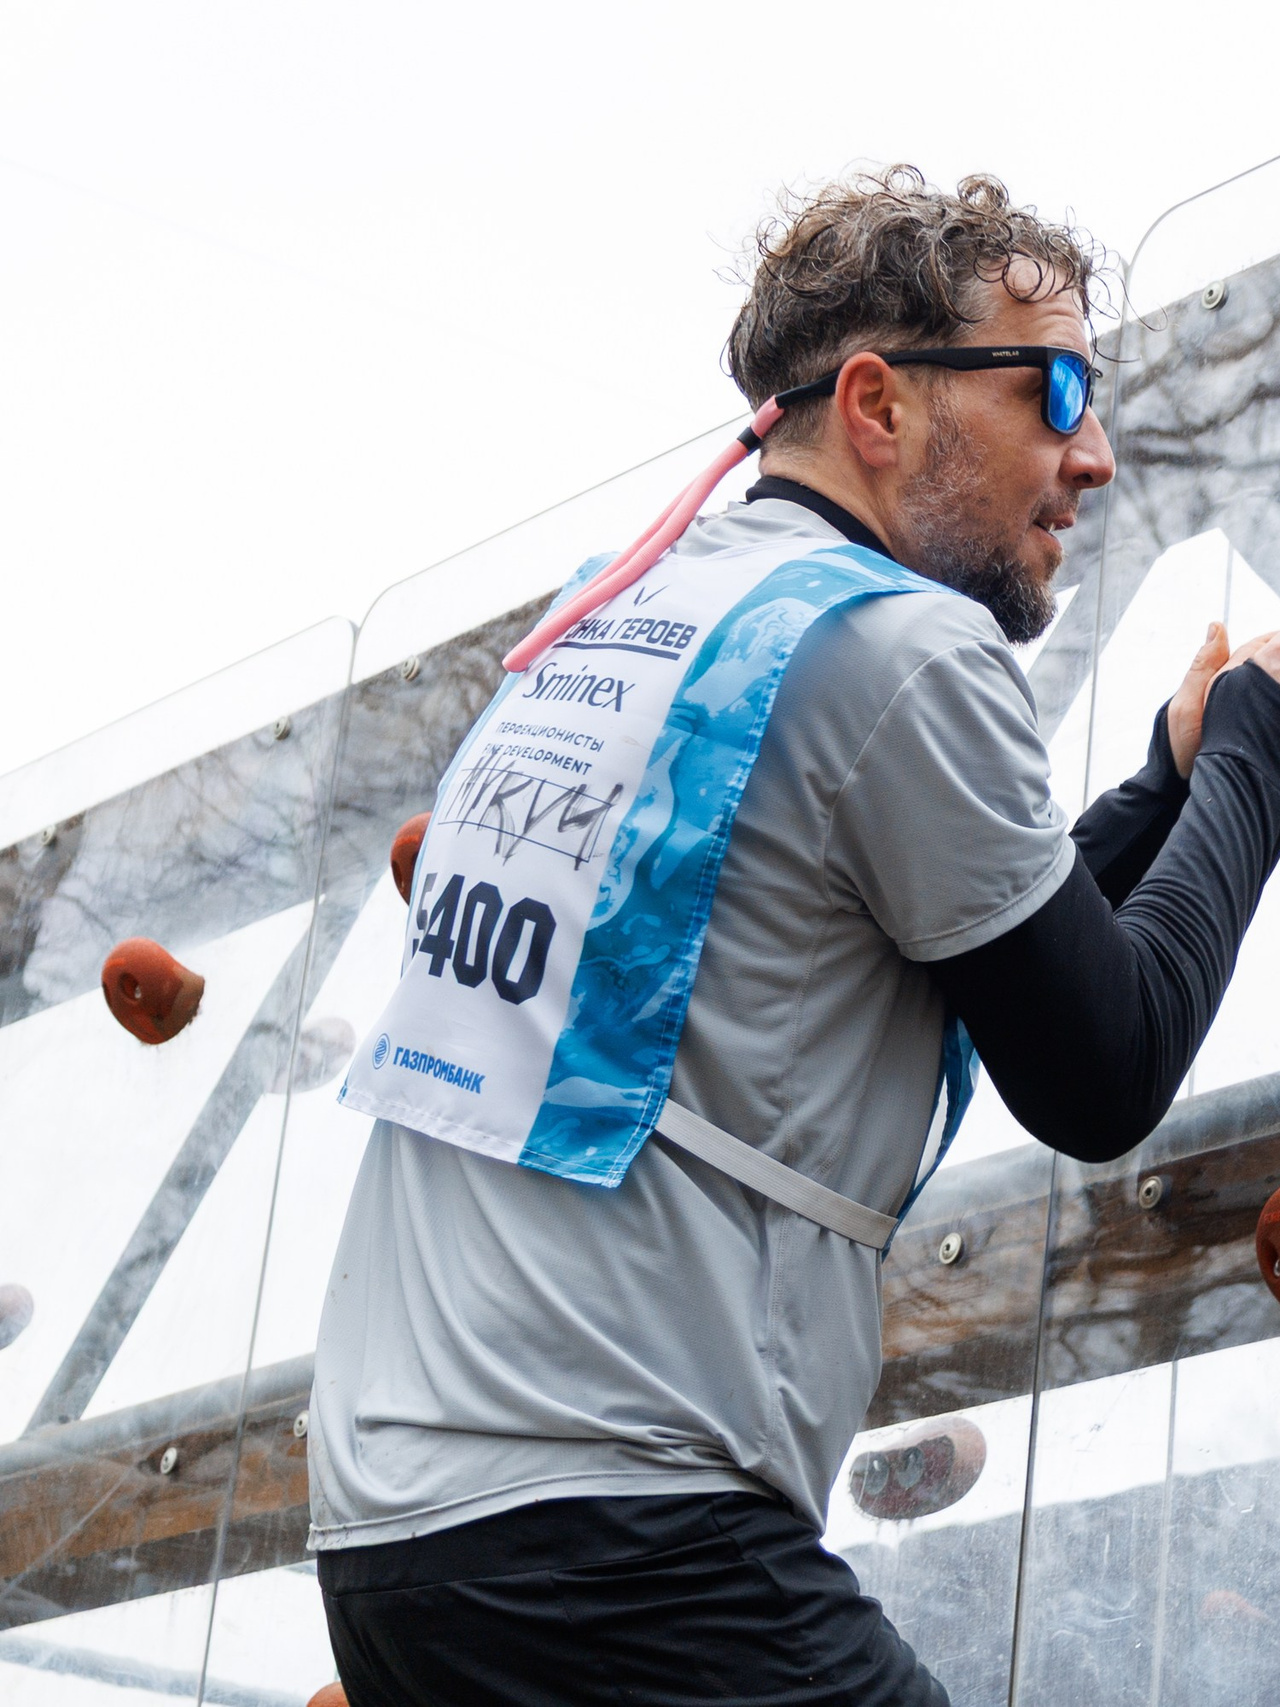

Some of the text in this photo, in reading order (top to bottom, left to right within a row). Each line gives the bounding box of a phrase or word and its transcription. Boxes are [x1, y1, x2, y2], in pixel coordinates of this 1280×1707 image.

[564, 617, 698, 650] ОНКА ГЕРОЕВ
[522, 662, 636, 713] Sminex
[496, 721, 605, 753] ПЕРФЕКЦИОНИСТЫ
[481, 742, 592, 776] FINE DEVELOPMENT
[393, 1046, 486, 1095] ГАЗПРОМБАНК
